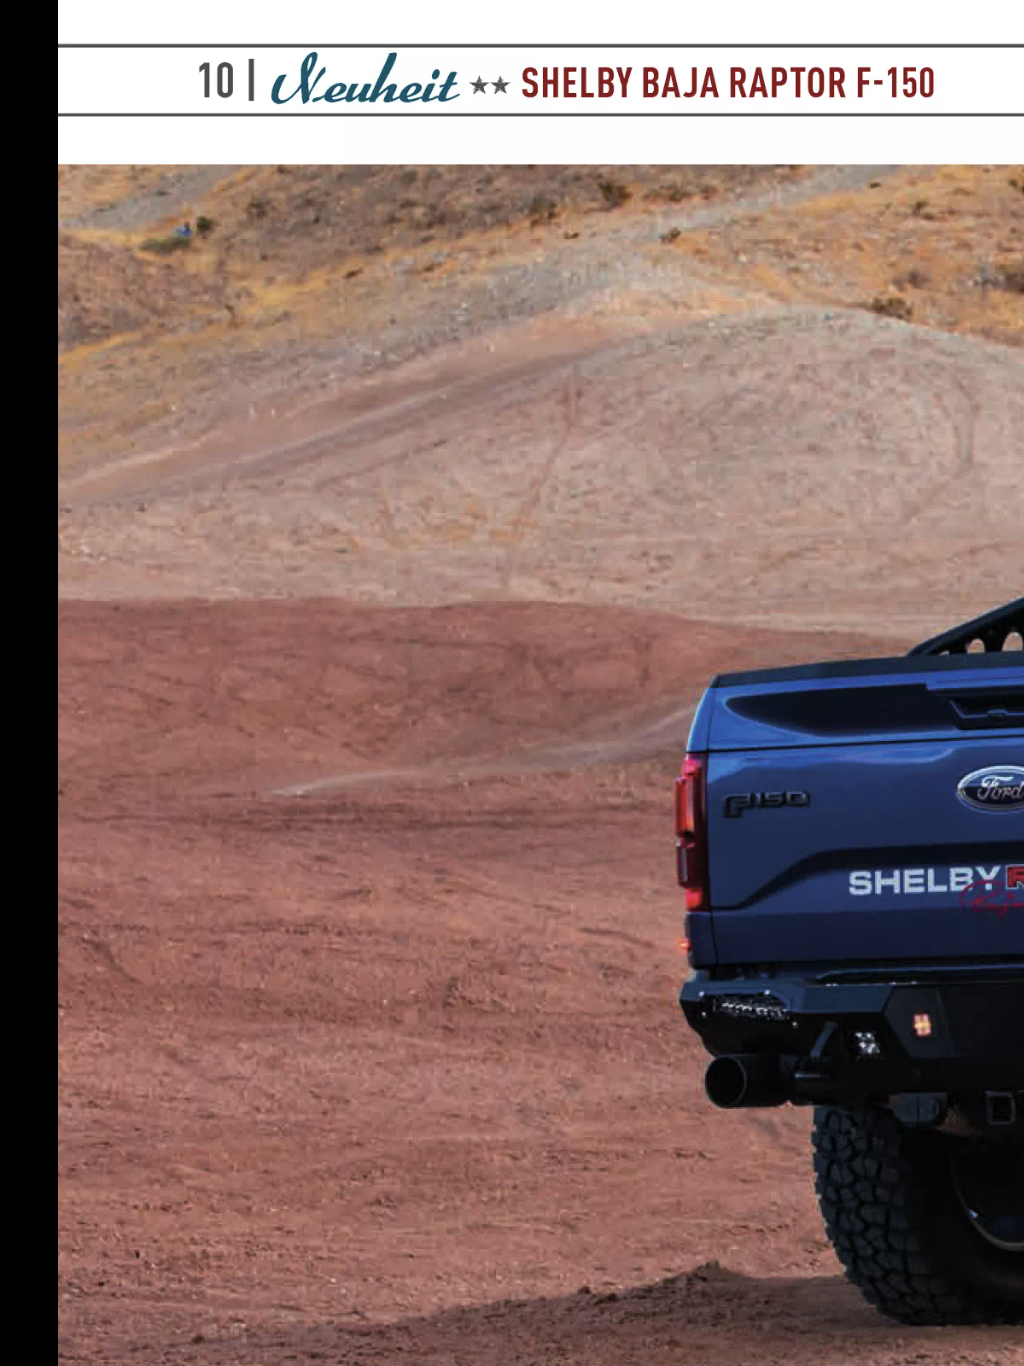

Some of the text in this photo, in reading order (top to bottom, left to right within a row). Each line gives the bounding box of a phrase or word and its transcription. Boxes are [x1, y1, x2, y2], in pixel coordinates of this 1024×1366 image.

[199, 52, 935, 105] 10 Neuheit SHELBY BAJA RAPTOR F-150
[848, 865, 1002, 896] SHELBY
